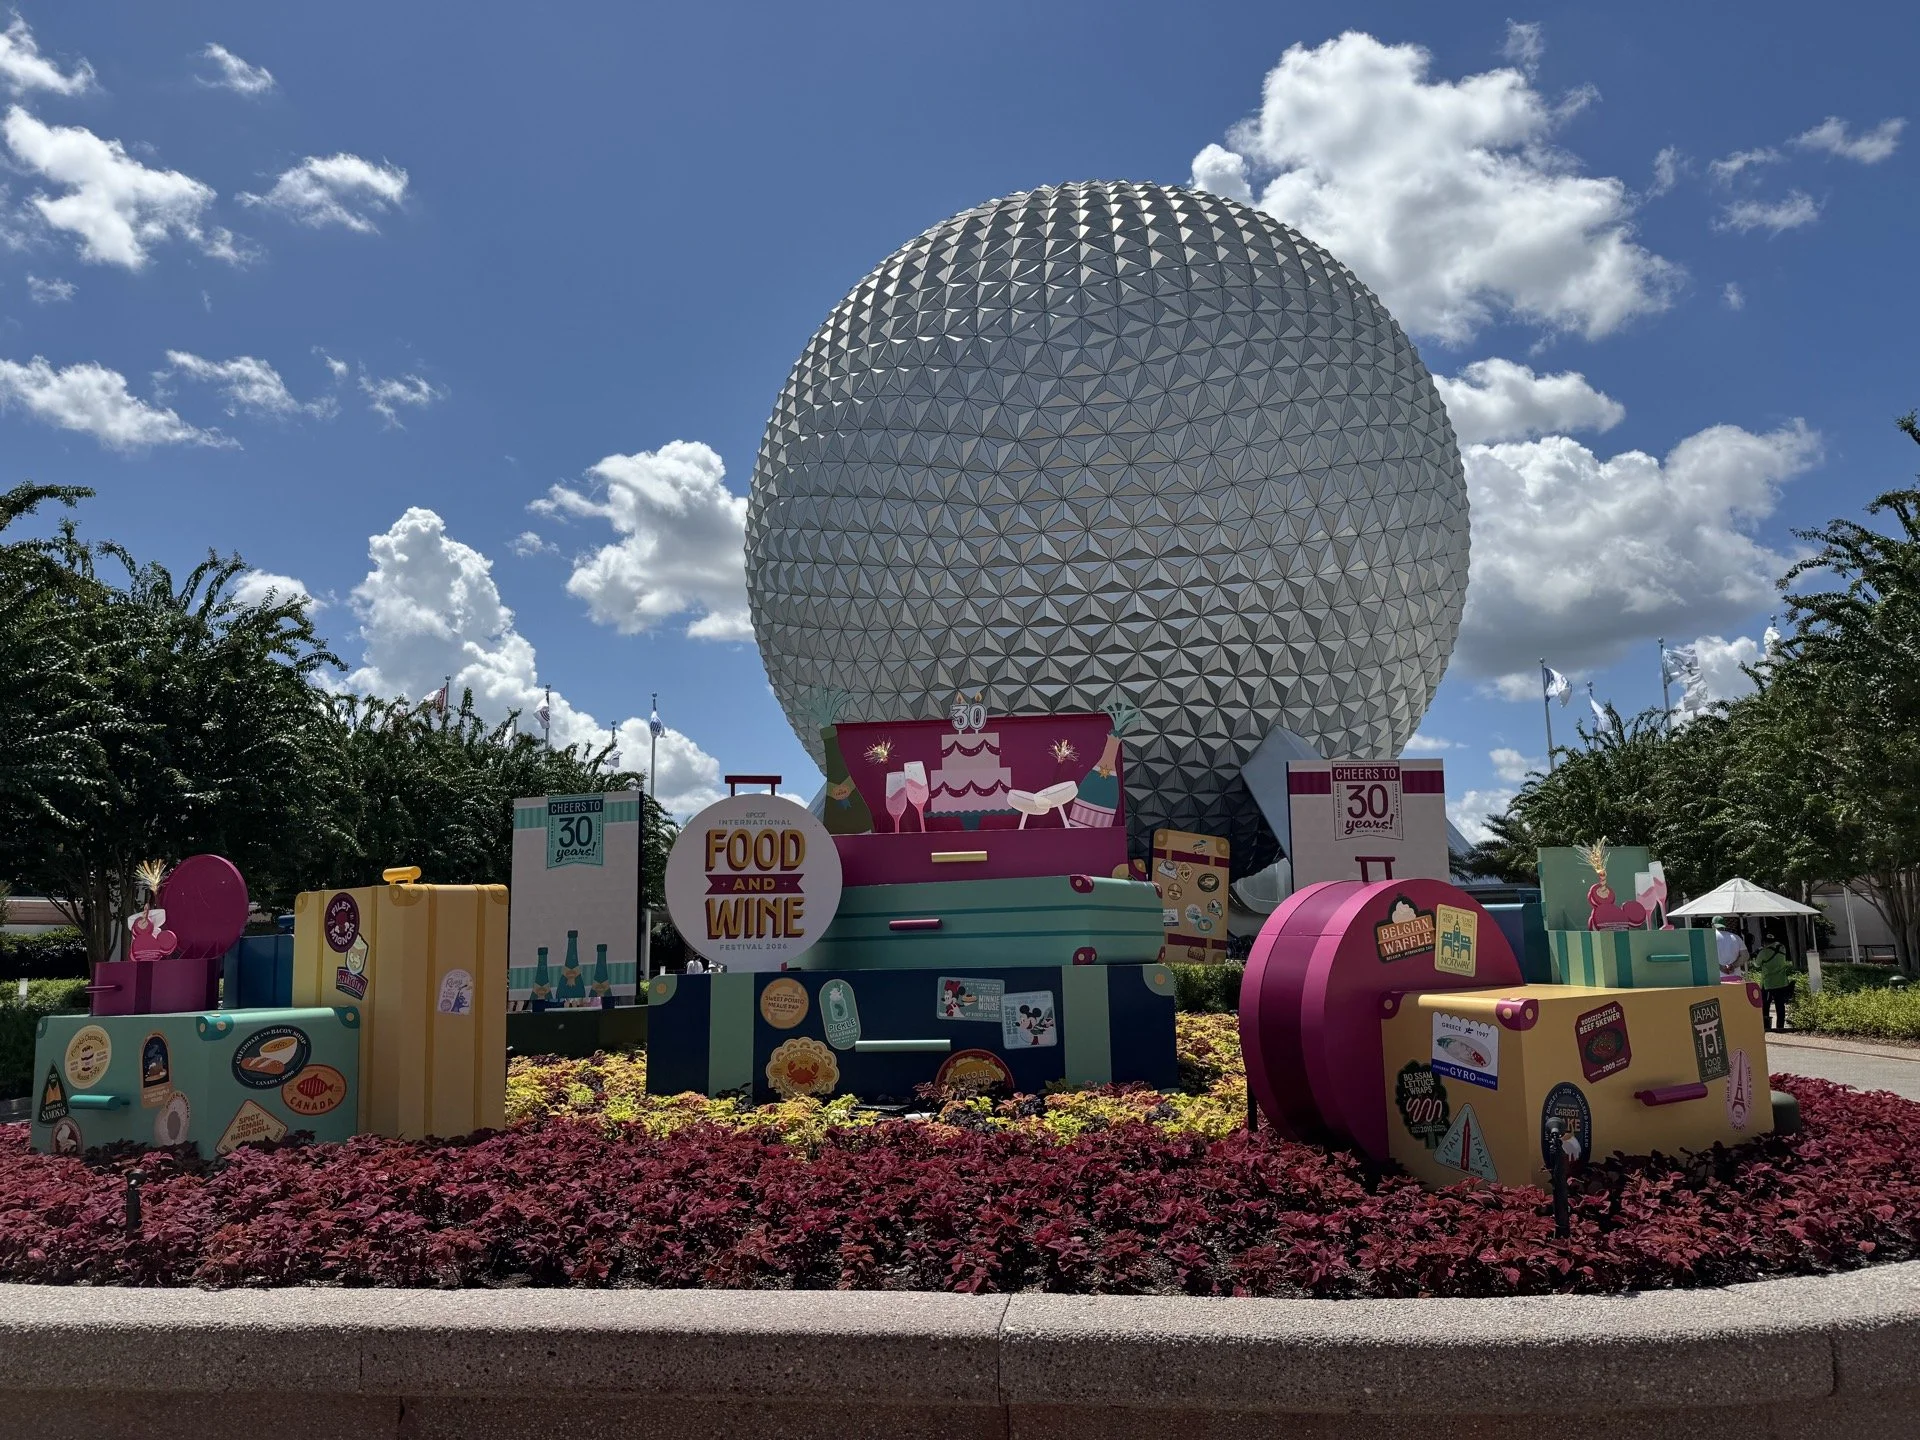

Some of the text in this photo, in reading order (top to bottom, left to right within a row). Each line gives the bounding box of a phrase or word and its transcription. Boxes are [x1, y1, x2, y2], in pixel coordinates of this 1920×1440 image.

[951, 703, 987, 730] 30
[1335, 768, 1396, 780] CHEERS TO
[551, 801, 601, 814] CHEERS TO
[1346, 784, 1389, 819] 30
[558, 815, 593, 848] 30
[1344, 813, 1395, 835] years!
[555, 841, 597, 863] years!
[704, 828, 806, 872] FOOD
[732, 878, 776, 891] AND
[331, 901, 351, 917] FILET
[704, 897, 805, 940] WINE
[329, 923, 356, 946] MIGNON
[1381, 918, 1429, 940] BELGIAN
[1383, 932, 1433, 955] WAFFLE
[1441, 956, 1471, 970] NORWAY
[979, 994, 1000, 1002] MINNIE
[978, 1002, 1000, 1011] MOUSE
[1694, 1005, 1719, 1023] JAPAN
[828, 1018, 857, 1033] PICKLE
[1442, 1022, 1462, 1032] GREECE
[1580, 1011, 1621, 1035] BEEF SKEWER
[235, 1035, 260, 1065] CHEDDAR
[271, 1028, 293, 1036] BACON
[293, 1030, 307, 1045] SOUP
[1705, 1056, 1722, 1068] FOOD
[1706, 1064, 1723, 1076] WINE
[955, 1069, 991, 1082] TACO DE
[1403, 1071, 1433, 1082] BO SSAM
[1449, 1066, 1477, 1082] GYRO
[1404, 1079, 1435, 1089] LETTUCE
[1409, 1086, 1433, 1096] WRAPS
[289, 1096, 335, 1111] CANADA
[239, 1113, 261, 1125] SPICY
[1554, 1107, 1580, 1118] CARROT
[230, 1130, 252, 1142] HAND
[251, 1124, 271, 1136] ROLL
[1443, 1129, 1462, 1156] ITALY
[1472, 1136, 1489, 1169] ITALY
